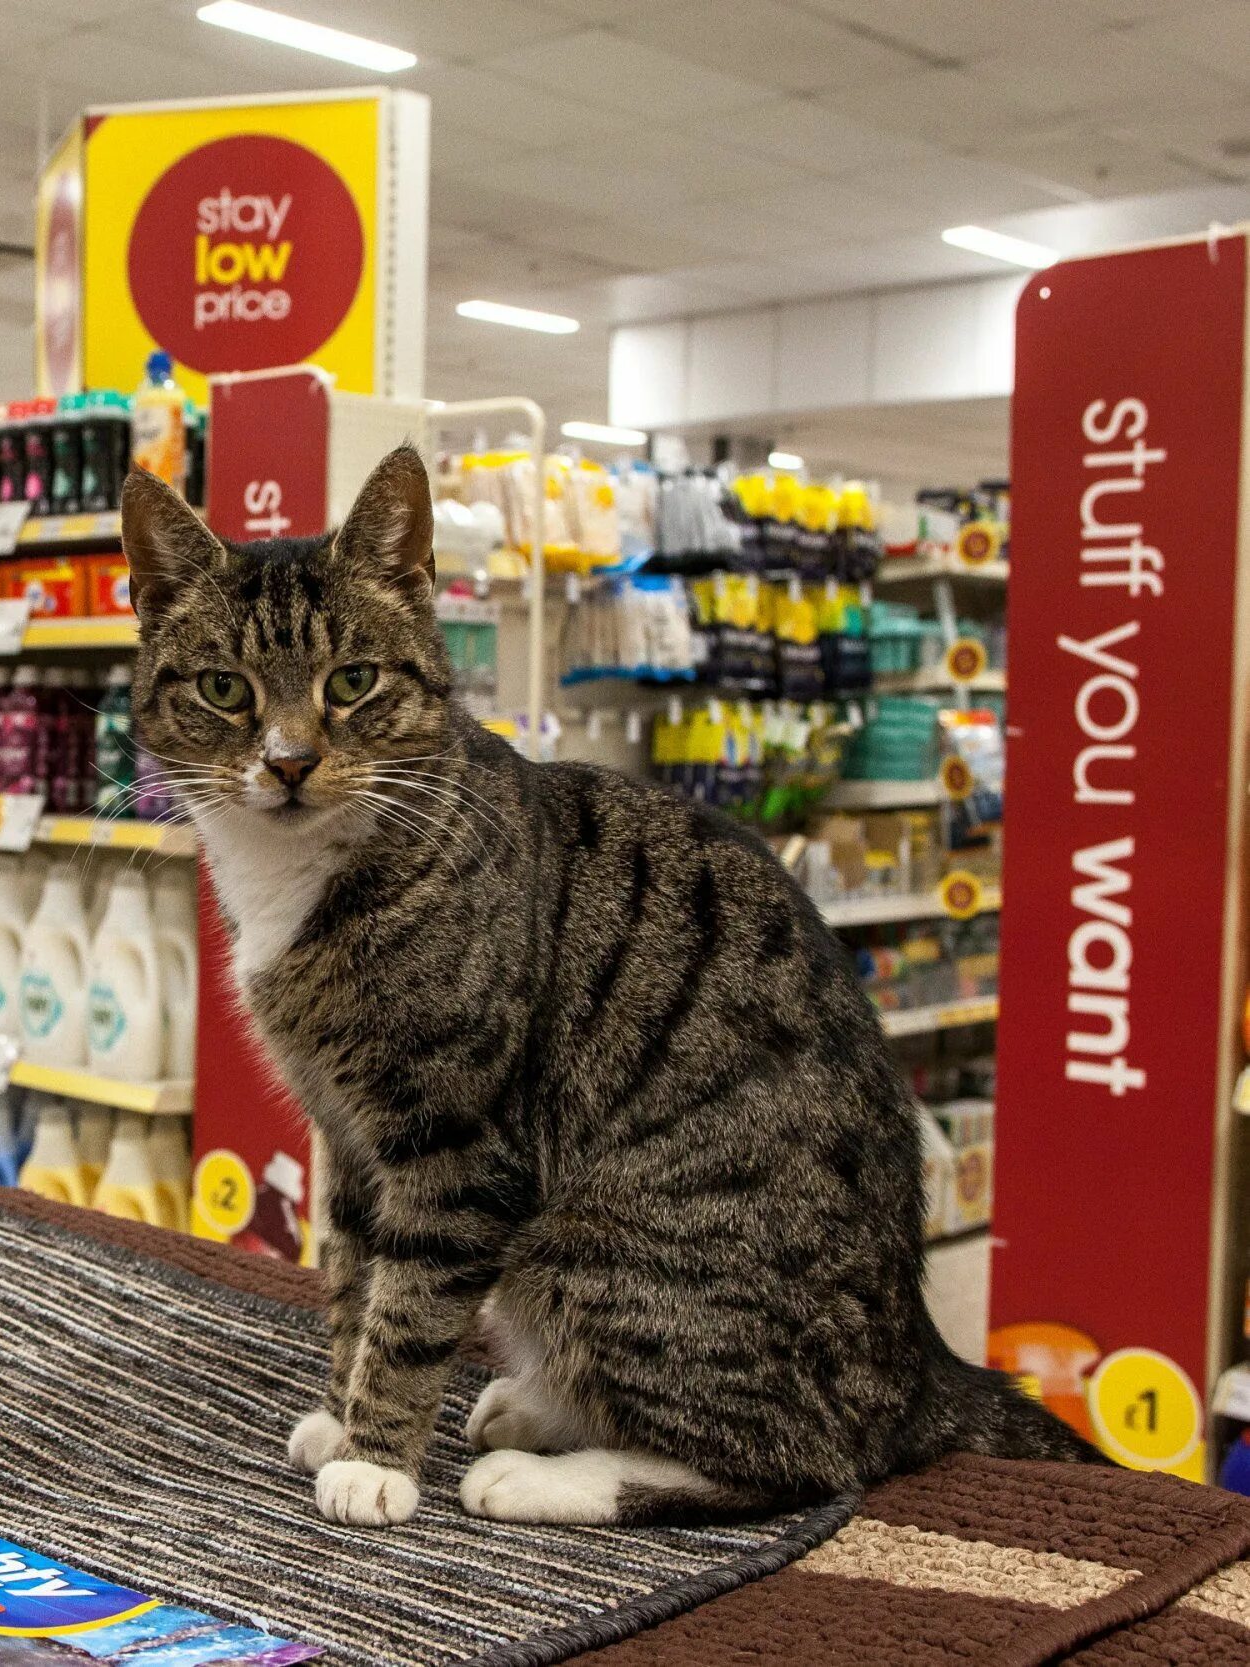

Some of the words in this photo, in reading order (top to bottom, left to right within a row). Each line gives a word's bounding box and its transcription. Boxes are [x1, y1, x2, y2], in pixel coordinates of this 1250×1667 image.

[196, 186, 293, 241] stay
[195, 234, 293, 285] low
[194, 283, 292, 330] price
[244, 480, 291, 542] st
[1081, 398, 1167, 597] stuff
[1058, 620, 1141, 804] you
[1065, 836, 1147, 1097] want
[1124, 1389, 1157, 1433] £1
